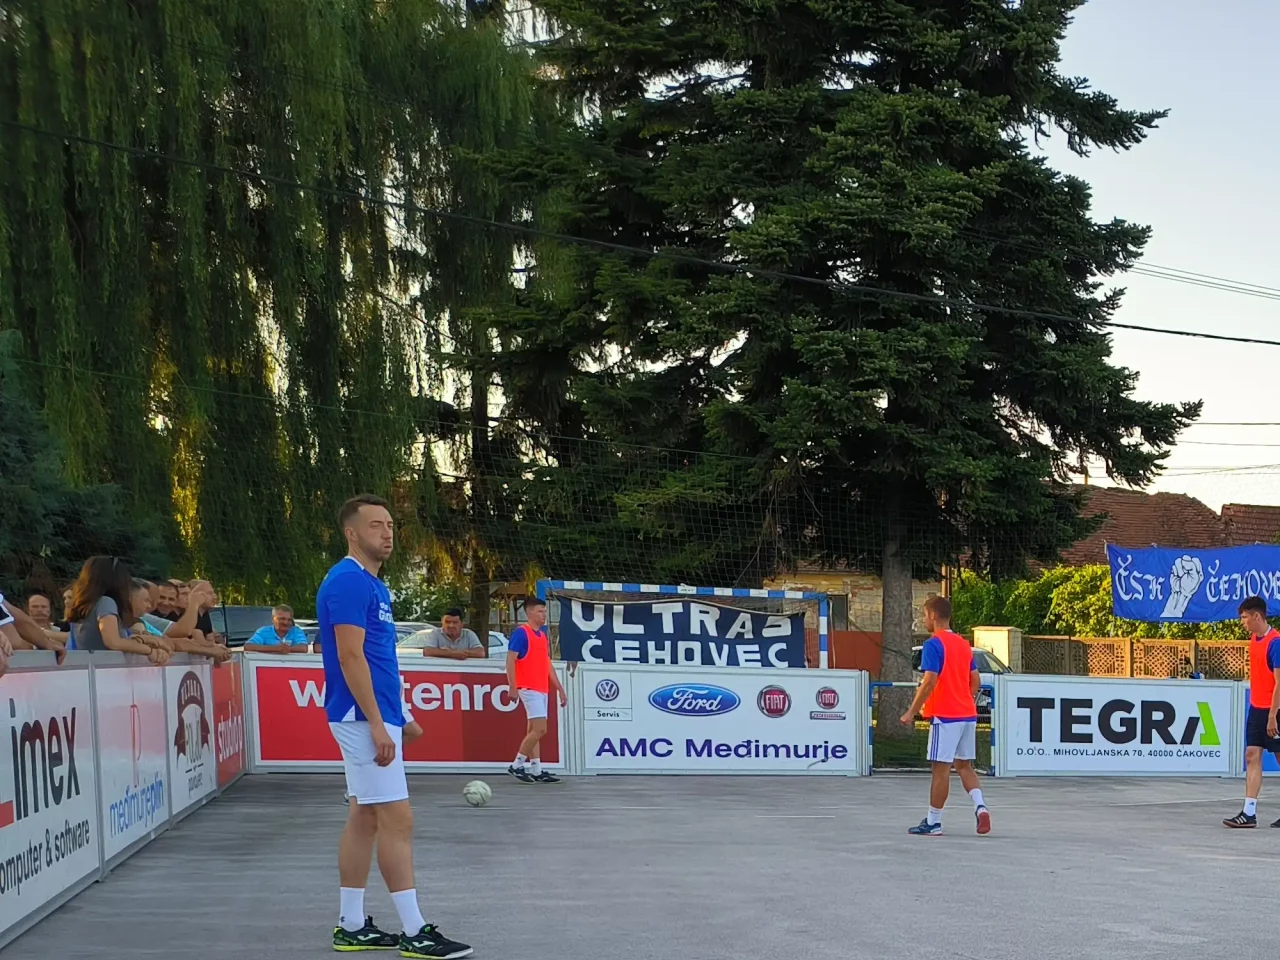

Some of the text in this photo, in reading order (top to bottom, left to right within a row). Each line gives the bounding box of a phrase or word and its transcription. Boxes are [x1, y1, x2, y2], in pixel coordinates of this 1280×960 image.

[581, 635, 789, 668] ČEHOVEC
[289, 671, 520, 713] wtenro
[668, 686, 722, 713] Ford
[765, 694, 784, 710] FIAT
[596, 710, 620, 719] Servis
[1017, 697, 1221, 745] TEGRA
[9, 698, 80, 821] imex
[595, 737, 849, 761] AMC Međimurje
[1053, 748, 1130, 757] MIHOVLJANSKA
[1147, 749, 1174, 757] 40000
[1176, 748, 1221, 758] ČAKOVEC
[0, 818, 90, 895] omputer & software
